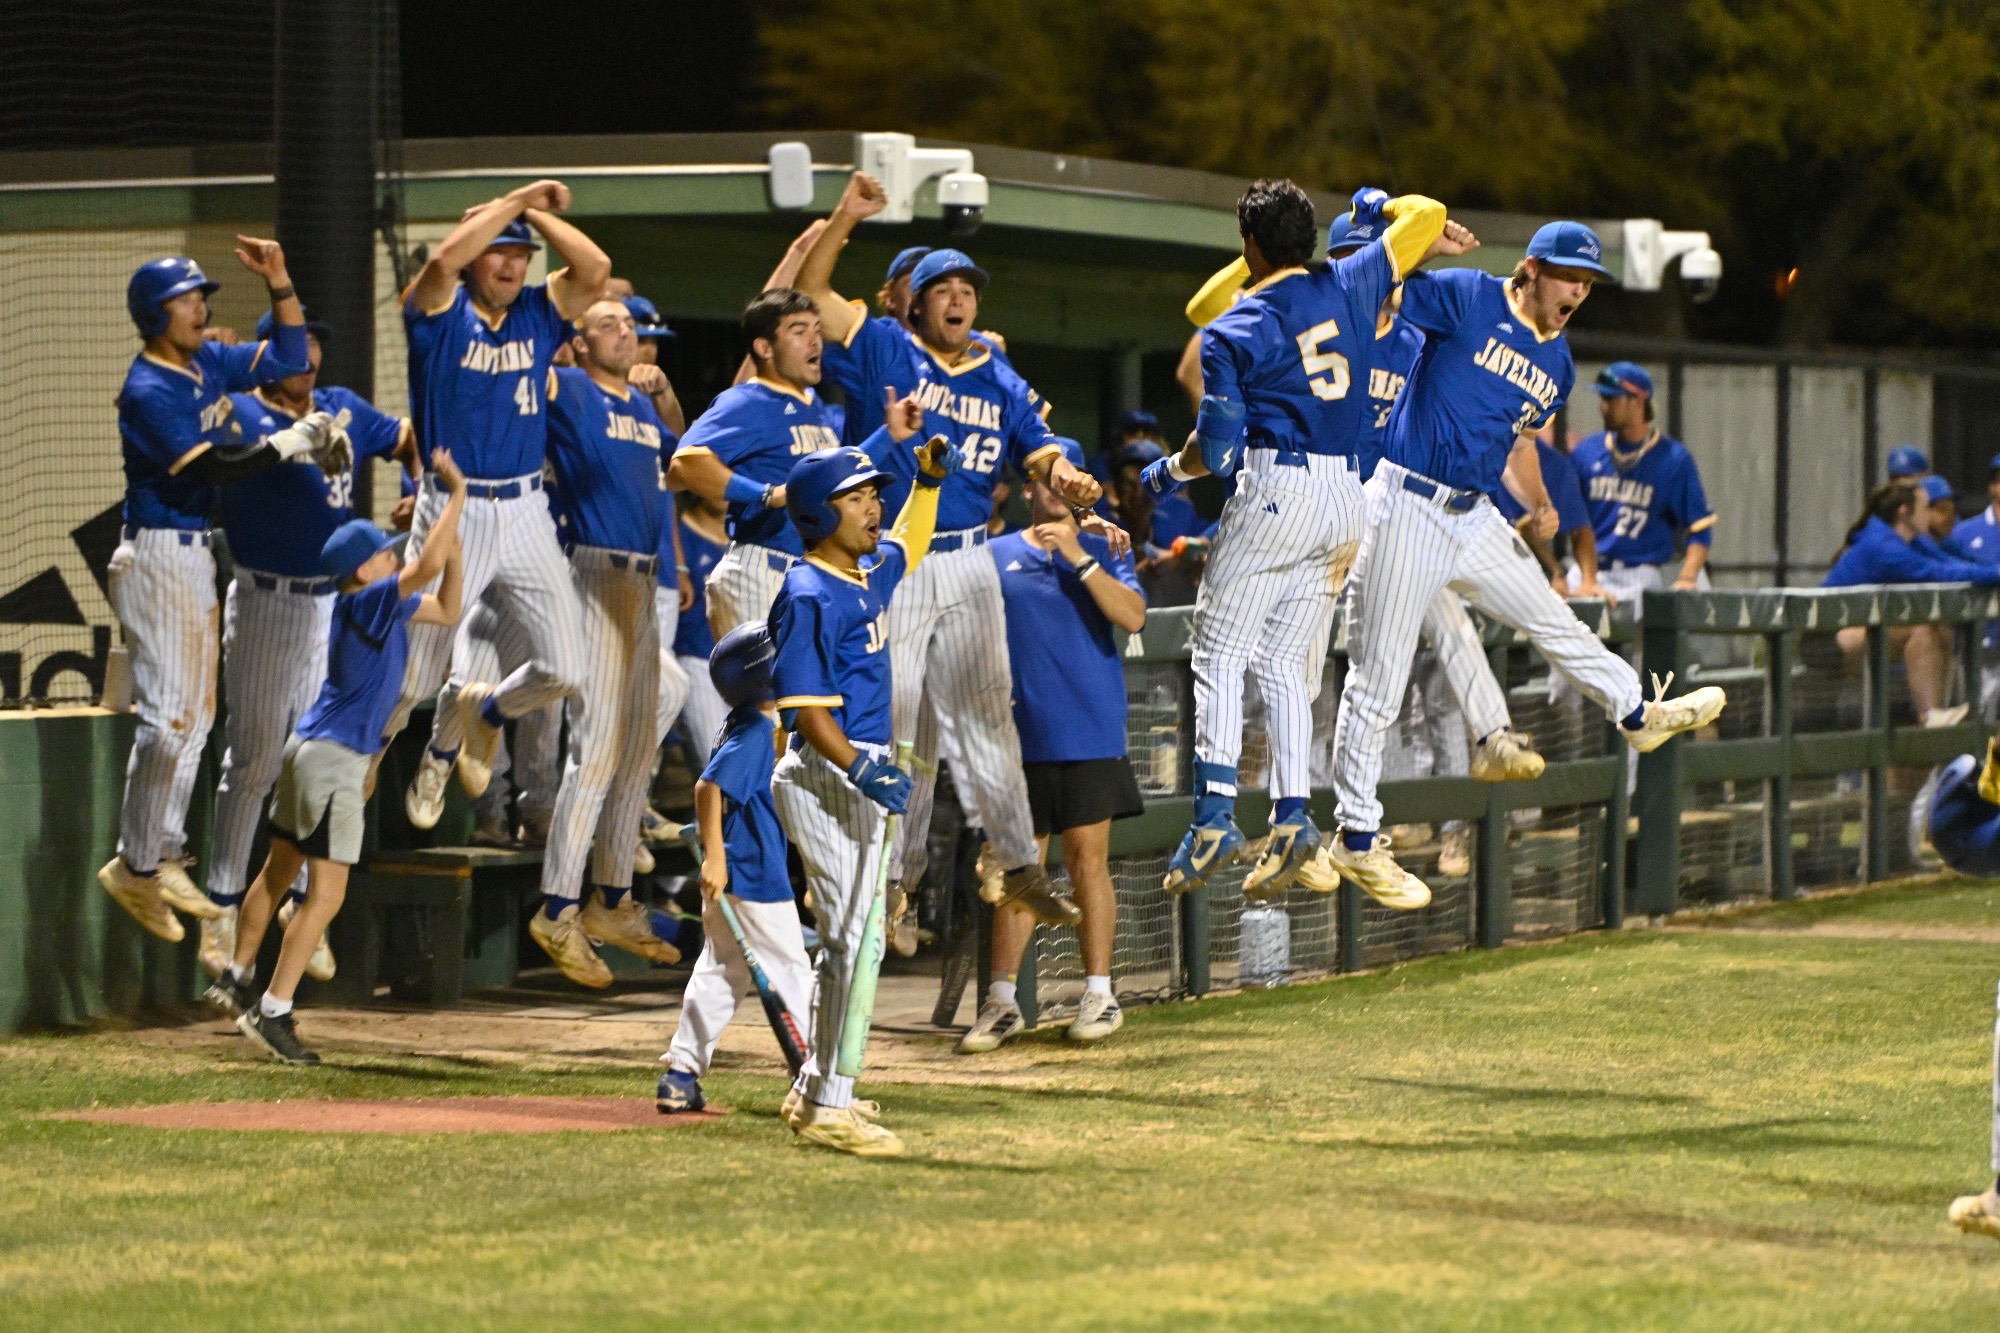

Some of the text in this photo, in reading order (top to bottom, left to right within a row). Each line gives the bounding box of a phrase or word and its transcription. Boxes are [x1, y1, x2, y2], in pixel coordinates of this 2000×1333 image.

[1296, 319, 1350, 401] 5
[1474, 337, 1558, 410] JAVELINAS
[514, 376, 538, 415] 41
[910, 378, 1000, 431] JAVELINAS
[961, 433, 1001, 474] 42
[324, 471, 353, 508] 32
[1614, 506, 1648, 539] 27
